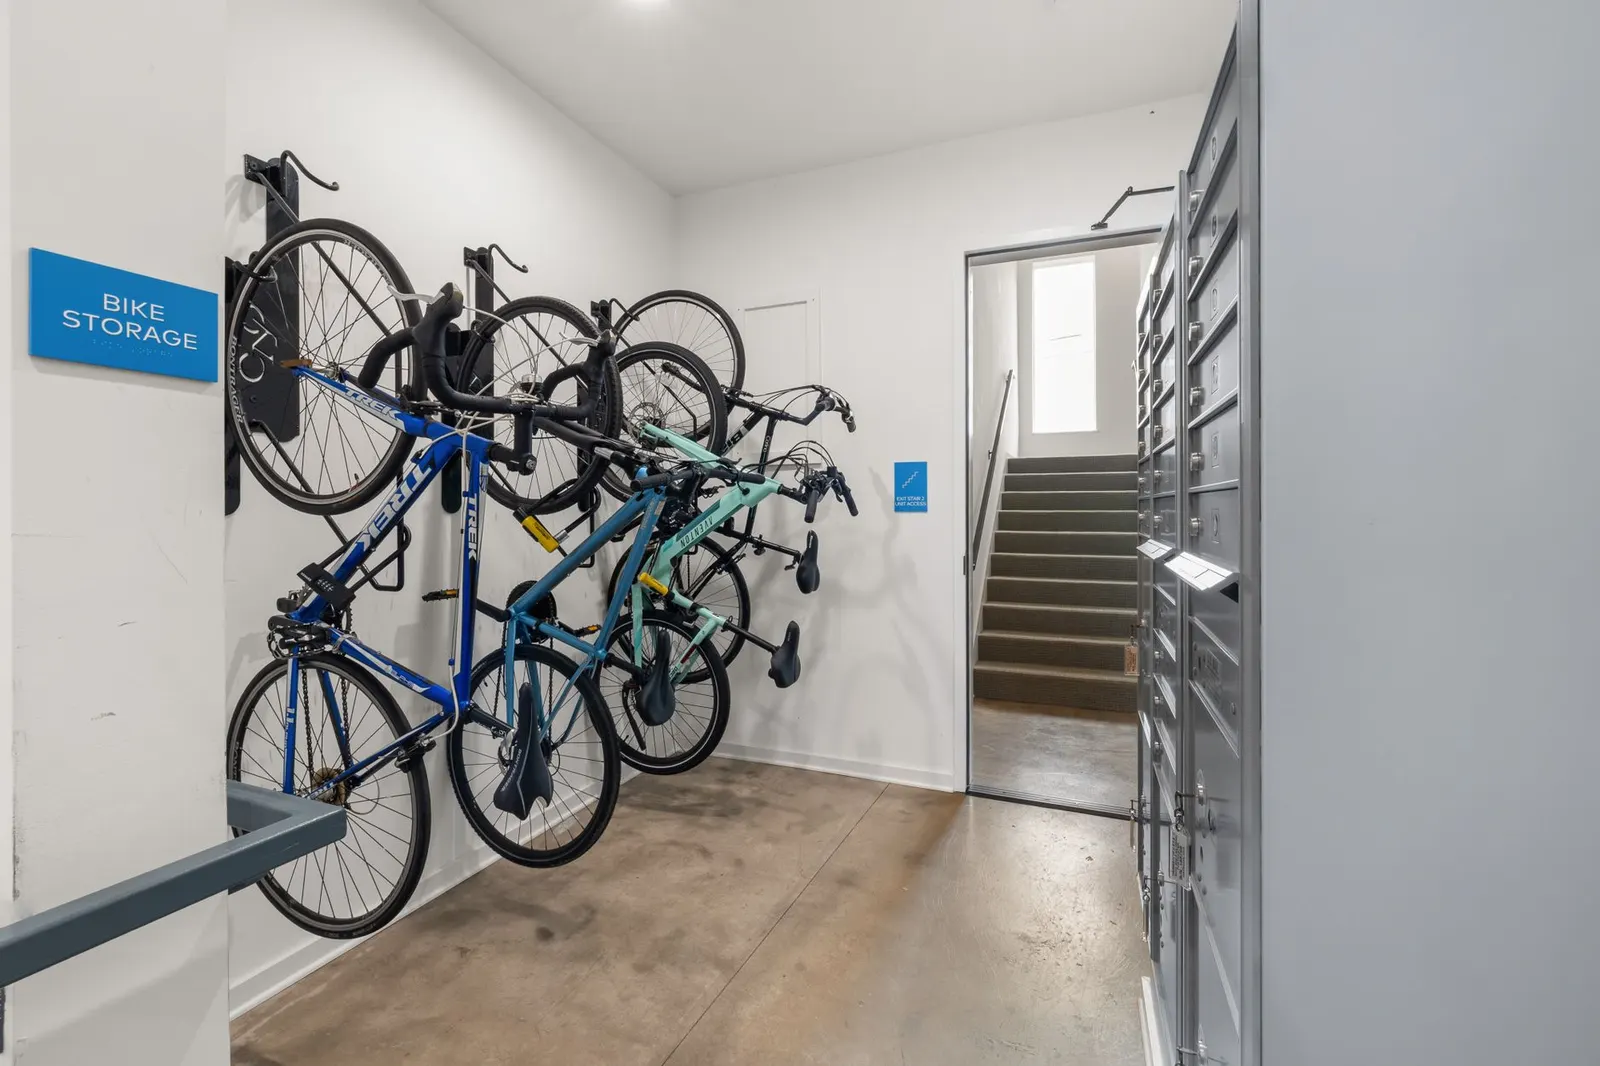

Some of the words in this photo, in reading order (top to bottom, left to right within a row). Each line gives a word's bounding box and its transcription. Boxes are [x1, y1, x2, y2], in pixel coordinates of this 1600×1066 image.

[103, 293, 165, 322] BIKE
[62, 309, 198, 350] STORAGE
[229, 335, 244, 424] BONTRAGER
[345, 387, 402, 421] TREK
[356, 463, 432, 552] TREK
[467, 493, 478, 560] TREK
[680, 516, 713, 549] AVENTON
